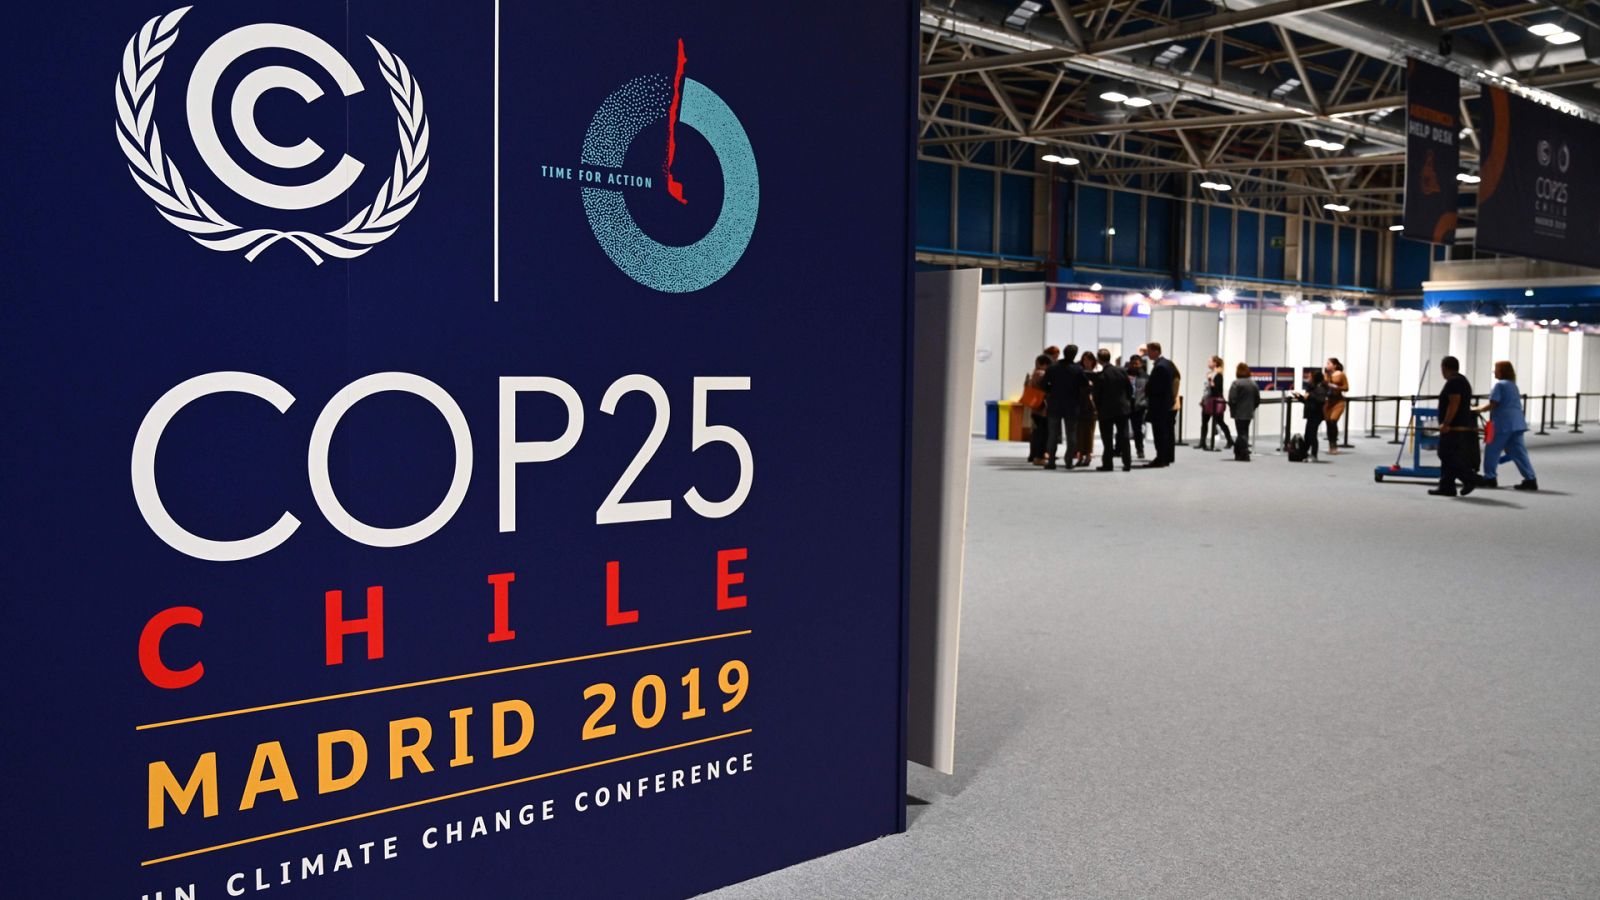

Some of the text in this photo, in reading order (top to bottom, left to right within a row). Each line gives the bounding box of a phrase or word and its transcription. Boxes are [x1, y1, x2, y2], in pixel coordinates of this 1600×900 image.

[541, 165, 652, 188] TIME FOR ACTION
[130, 370, 754, 562] COP25
[138, 547, 748, 690] CHILE
[148, 659, 751, 830] MADRID 2019
[226, 836, 399, 898] CLIMATE
[422, 799, 555, 850] CHANGE
[574, 752, 754, 813] CONFERENCE
